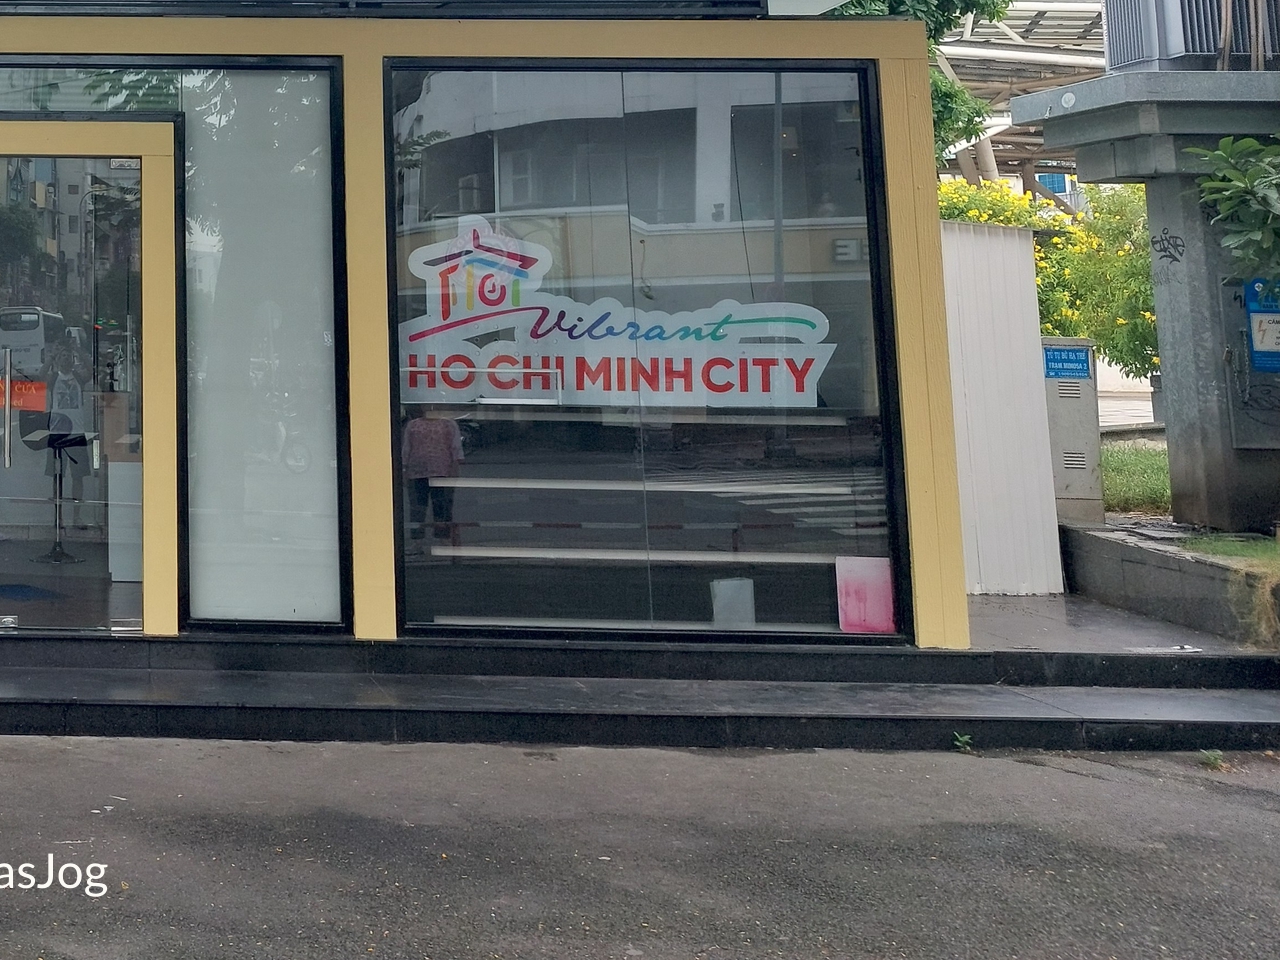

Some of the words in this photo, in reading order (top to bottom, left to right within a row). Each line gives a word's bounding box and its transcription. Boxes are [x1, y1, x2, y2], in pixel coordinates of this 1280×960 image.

[528, 305, 816, 342] Vibrant
[409, 353, 476, 391] HO
[486, 354, 564, 392] CHI
[576, 356, 693, 393] MINH
[701, 356, 816, 394] CITY
